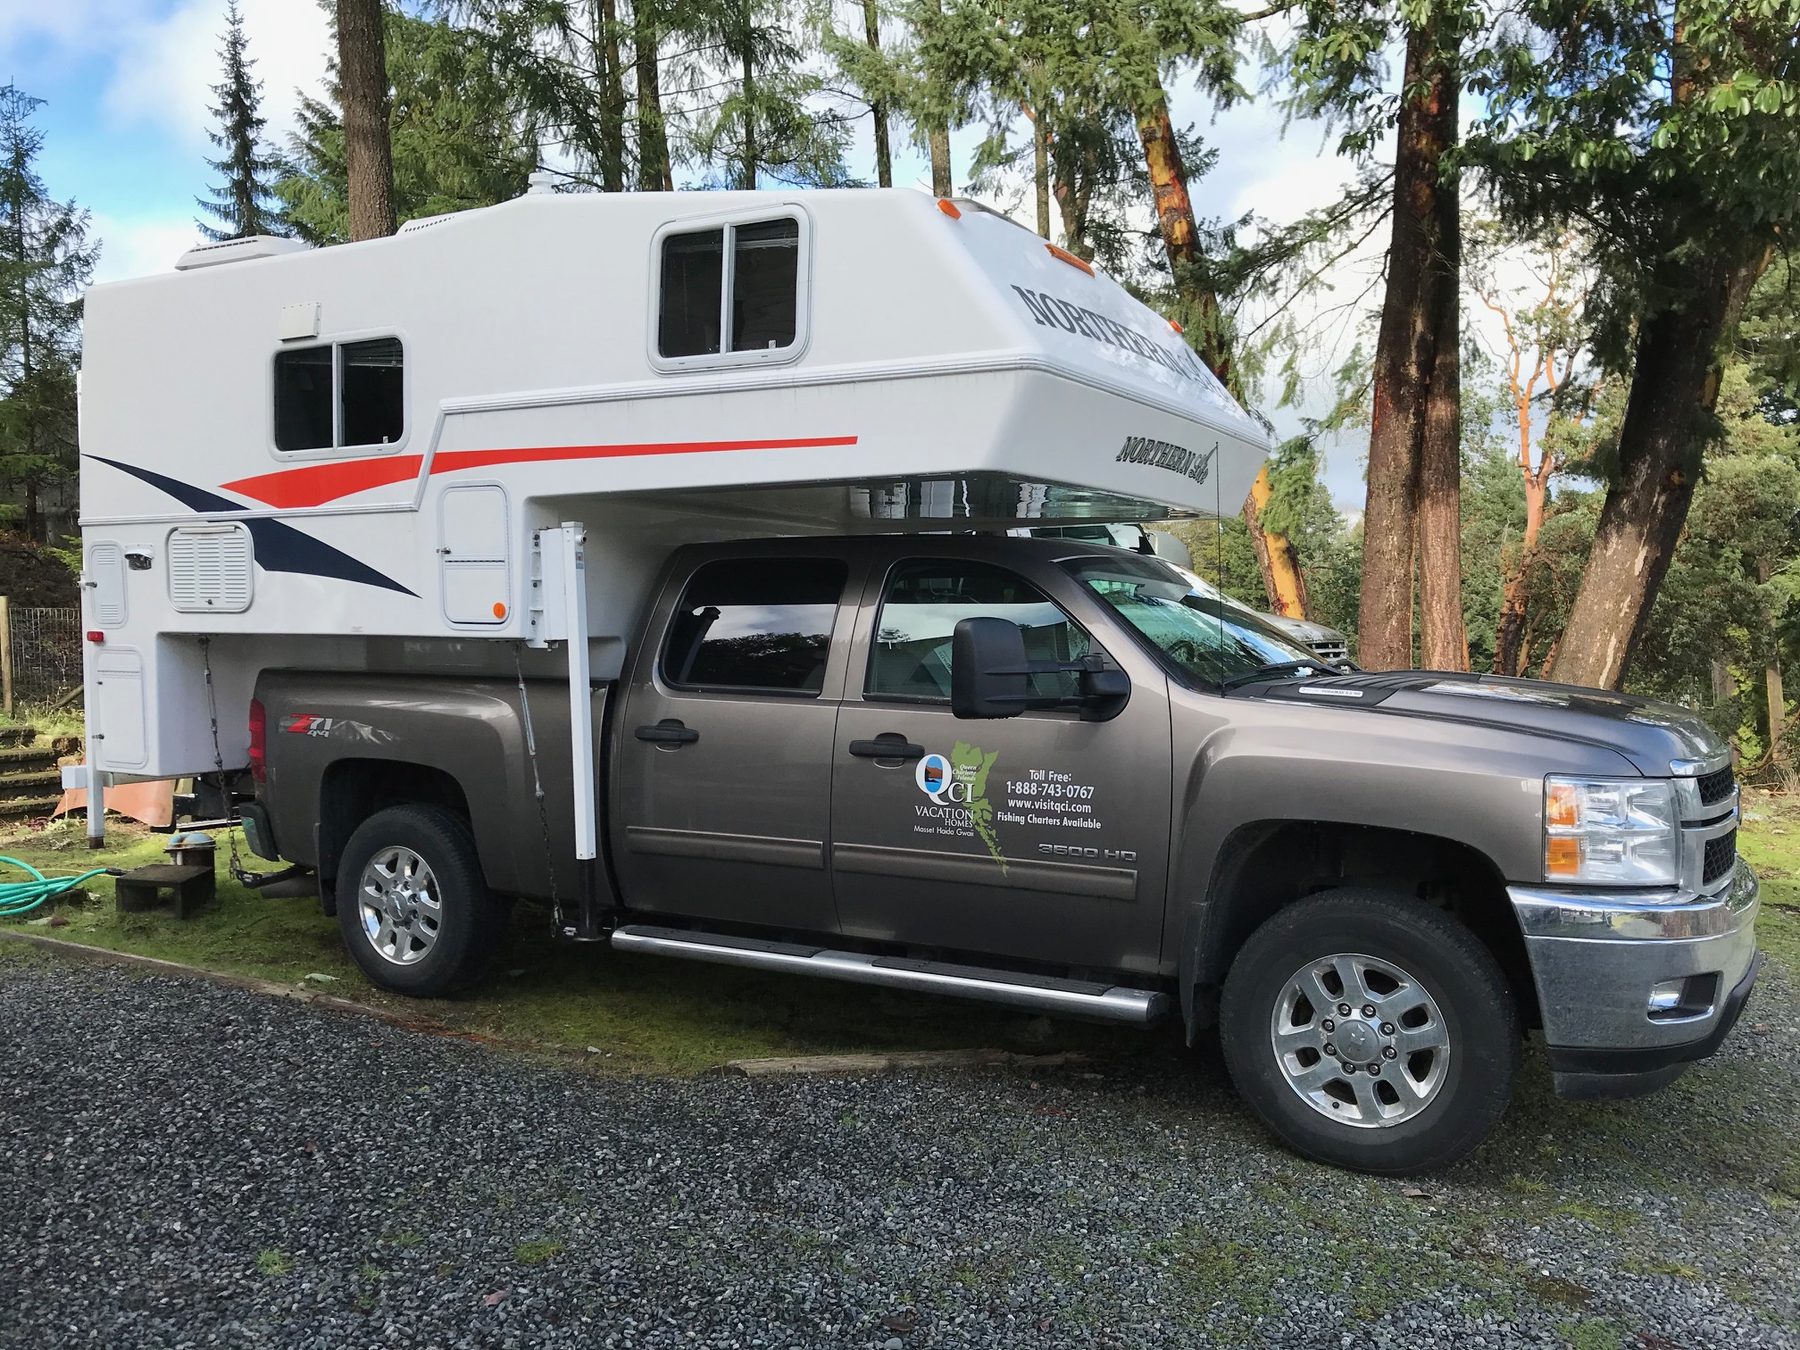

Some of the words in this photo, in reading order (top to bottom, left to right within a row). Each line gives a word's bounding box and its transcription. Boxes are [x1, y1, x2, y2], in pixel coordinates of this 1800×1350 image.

[1010, 284, 1193, 381] NORTHERN
[1115, 436, 1196, 475] NORTHERN
[287, 713, 333, 732] Z71
[915, 753, 976, 806] QCI
[1029, 769, 1045, 781] Toll
[1048, 770, 1072, 783] Free:
[1006, 780, 1095, 799] 1-888-743-0767
[915, 805, 974, 820] VACATION
[1007, 798, 1092, 814] www.visitqci.com
[913, 825, 935, 833] Masset
[944, 818, 973, 828] HOMES
[997, 811, 1025, 825] Fishing
[1027, 813, 1060, 826] Charters
[1062, 816, 1102, 829] Available
[1038, 843, 1099, 858] 3500
[1104, 849, 1137, 862] HD
